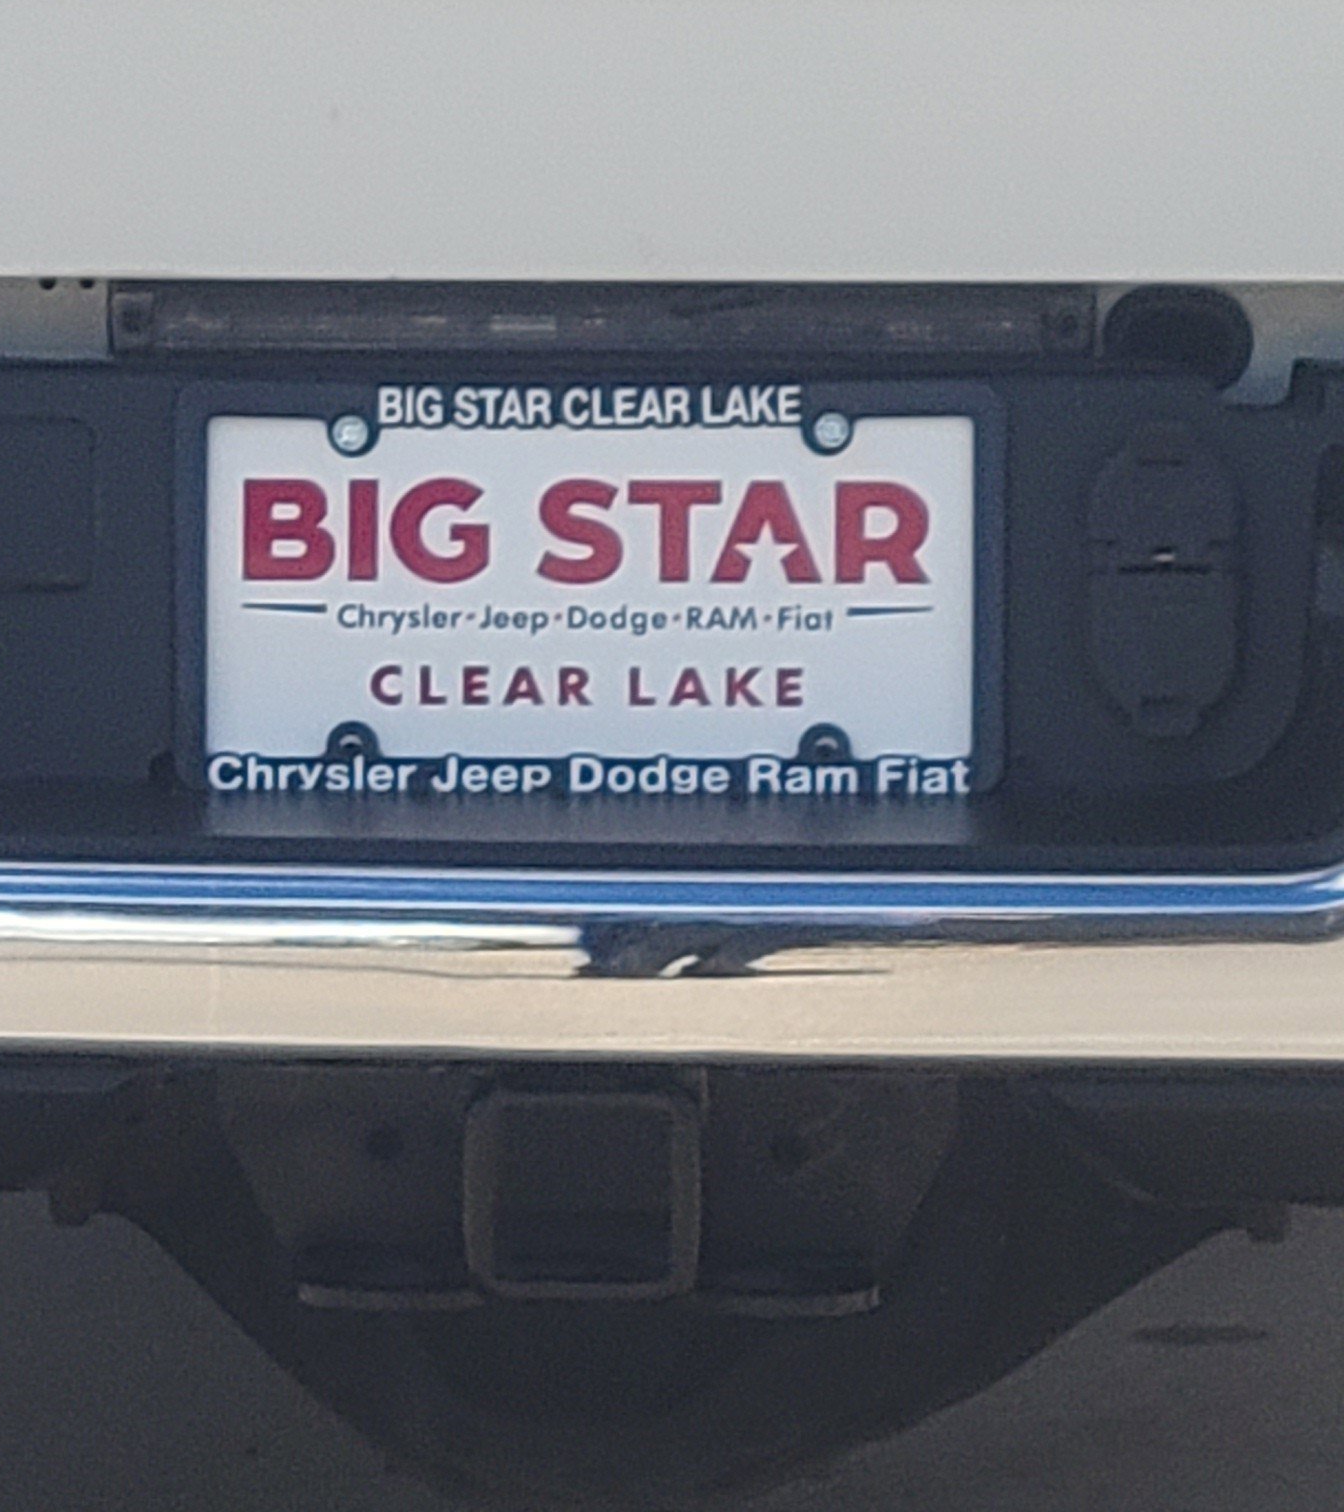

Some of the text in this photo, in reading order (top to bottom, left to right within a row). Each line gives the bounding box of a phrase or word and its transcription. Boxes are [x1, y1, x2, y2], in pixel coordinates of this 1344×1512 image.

[377, 384, 803, 427] BIG STAR CLEAR LAKE
[240, 476, 931, 586] BIG STAR
[336, 602, 835, 635] Chrysler Jeep Dodge RAM Fiat
[369, 663, 807, 708] CLEAR LAKE
[207, 754, 972, 795] Chrysler Jeep Dodge Ram Fiat
